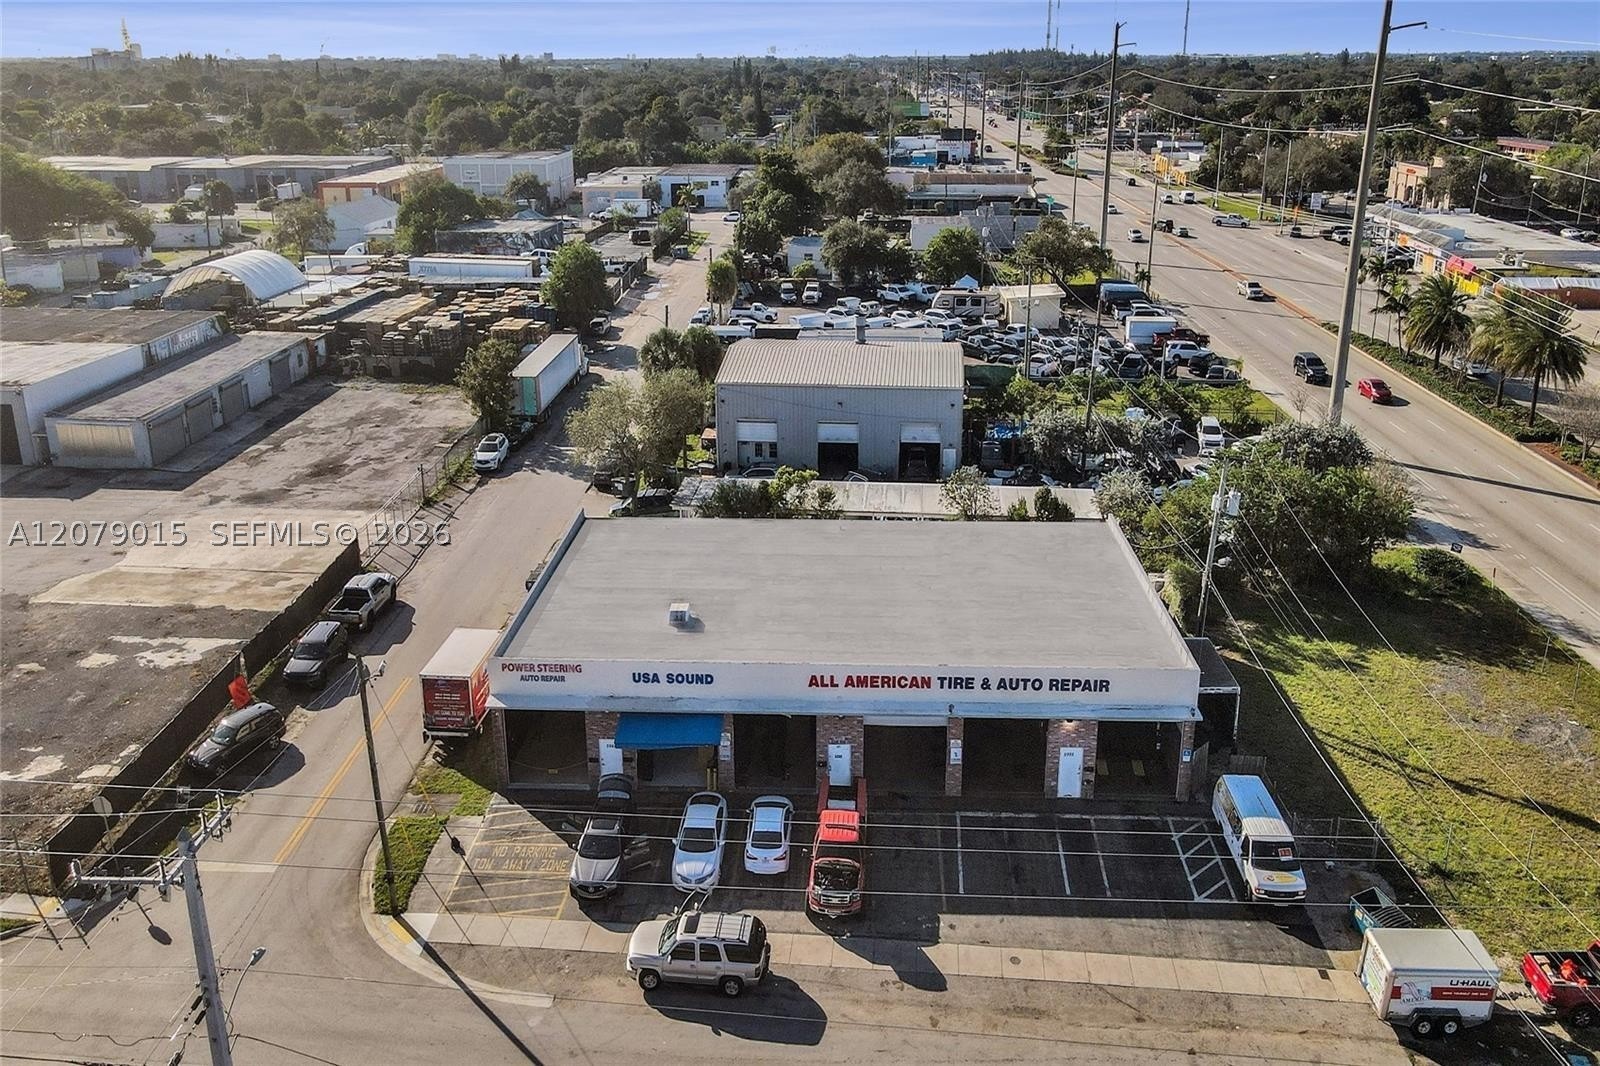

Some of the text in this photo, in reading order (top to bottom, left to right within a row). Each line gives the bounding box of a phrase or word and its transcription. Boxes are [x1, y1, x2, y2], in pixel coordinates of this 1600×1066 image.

[501, 663, 582, 674] POWER STEERING
[540, 675, 566, 683] REPAIR
[632, 672, 714, 685] USA SOUND
[808, 675, 1110, 692] ALL AMERICAN TIRE & AUTO REPAIR
[492, 846, 558, 858] NO PARKING
[473, 859, 569, 871] TOW AWAY ZONE
[1450, 979, 1492, 987] U-HAUL
